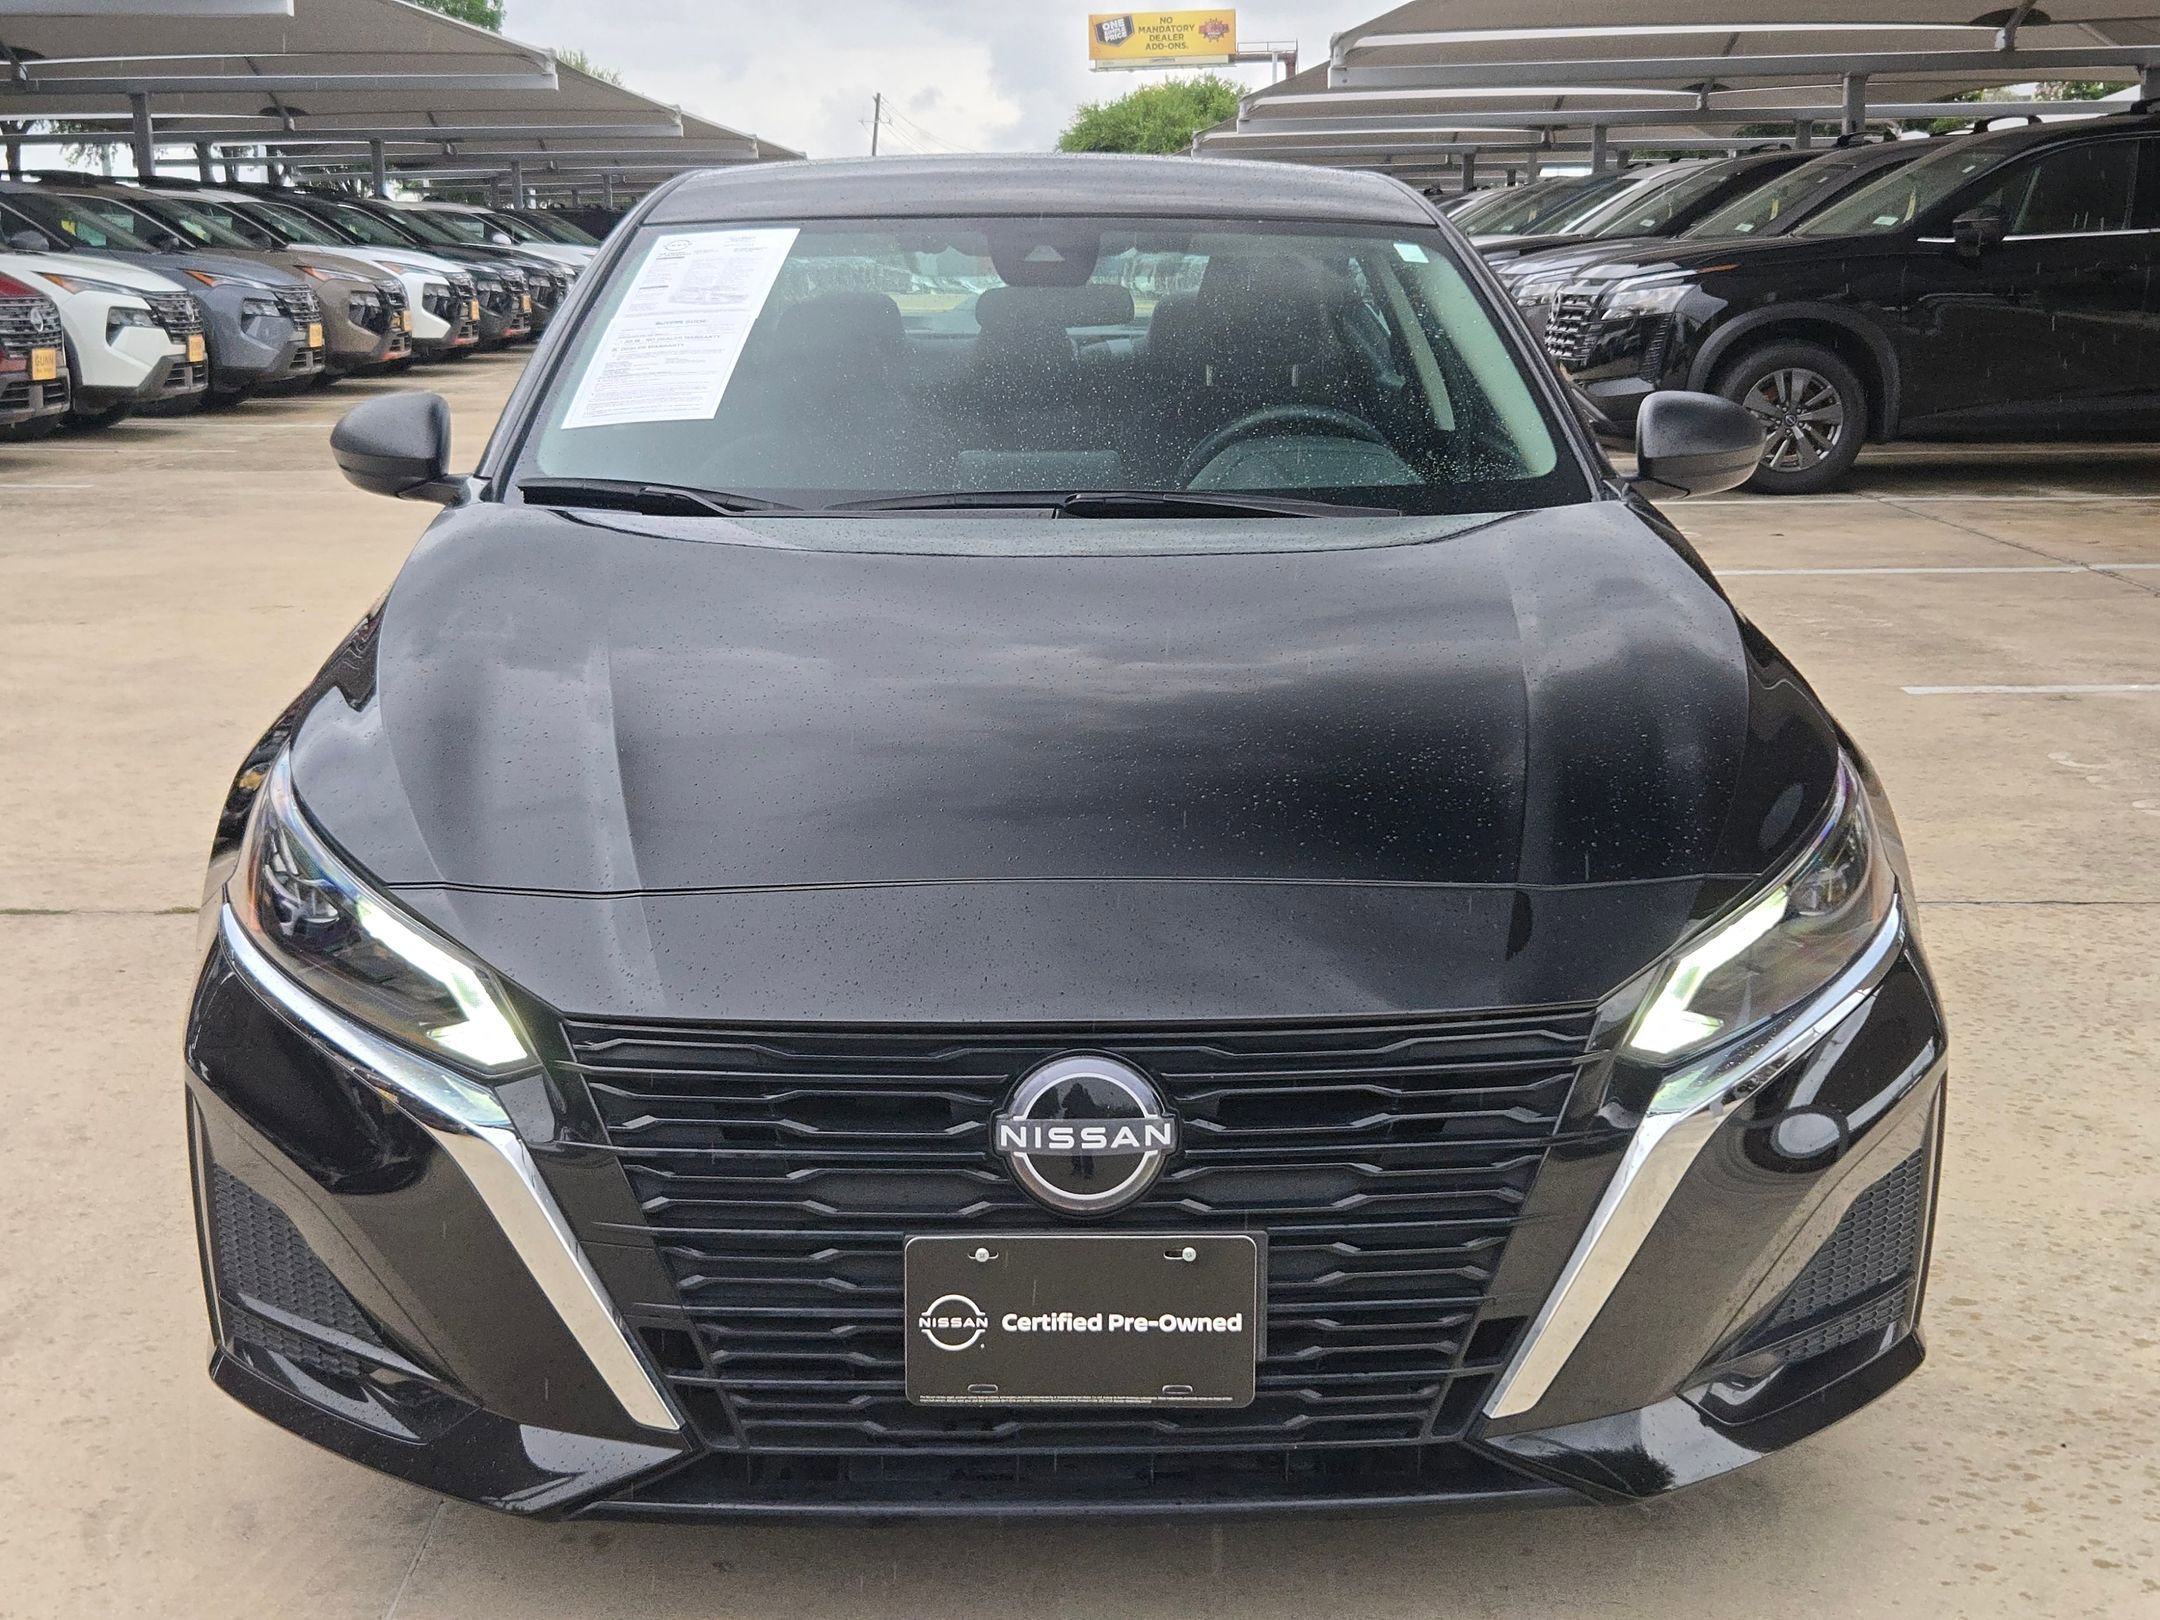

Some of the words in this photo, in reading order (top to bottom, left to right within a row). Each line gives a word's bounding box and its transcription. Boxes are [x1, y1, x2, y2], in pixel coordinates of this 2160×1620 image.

[1102, 18, 1125, 31] ONE
[1160, 16, 1173, 24] NO
[1138, 24, 1195, 34] MANDATORY
[1105, 31, 1127, 42] PRICE
[1149, 33, 1184, 41] DEALER
[1000, 1123, 1172, 1149] NISSAN
[919, 1317, 988, 1328] NISSAN
[1001, 1312, 1102, 1332] Certified
[1108, 1312, 1243, 1332] Pre-Owned
